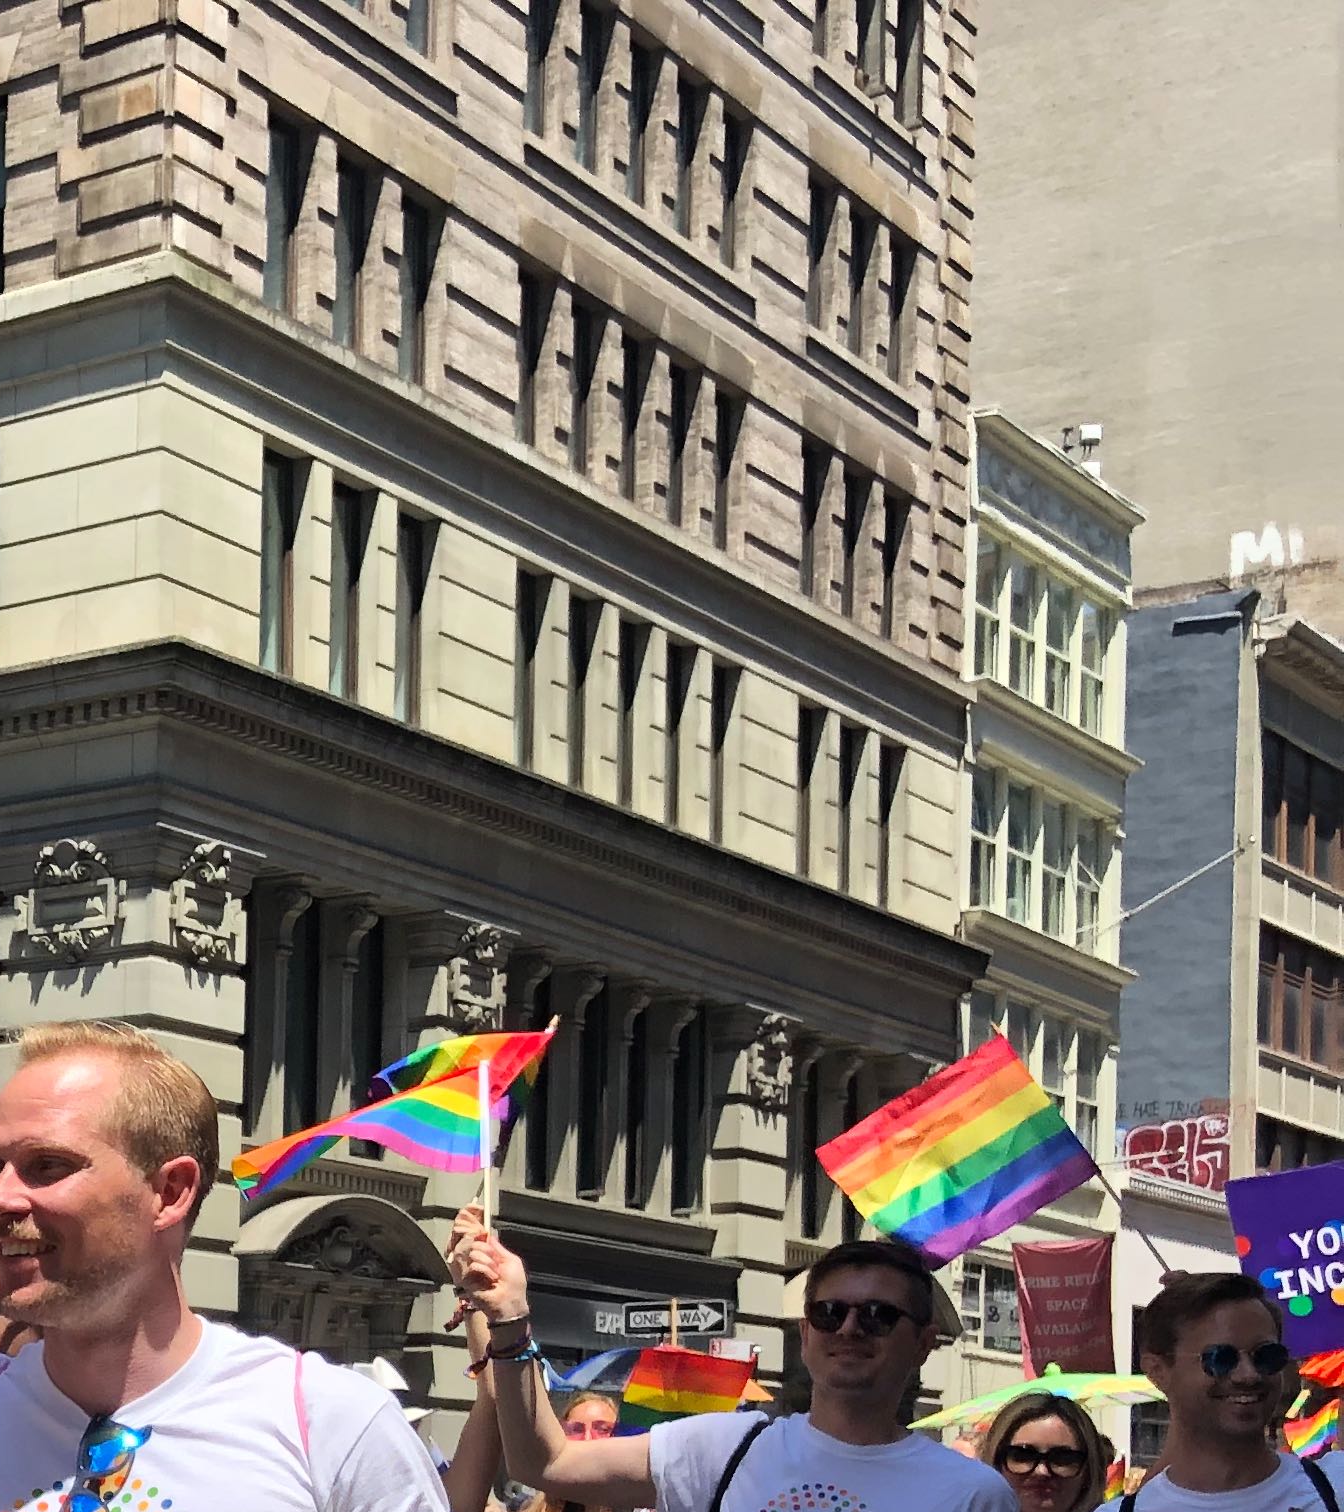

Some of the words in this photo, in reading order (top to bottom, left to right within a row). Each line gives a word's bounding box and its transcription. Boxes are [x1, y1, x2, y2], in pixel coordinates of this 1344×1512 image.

[1288, 1225, 1344, 1260] YO
[632, 1312, 662, 1327] ONE
[679, 1311, 711, 1325] WAY
